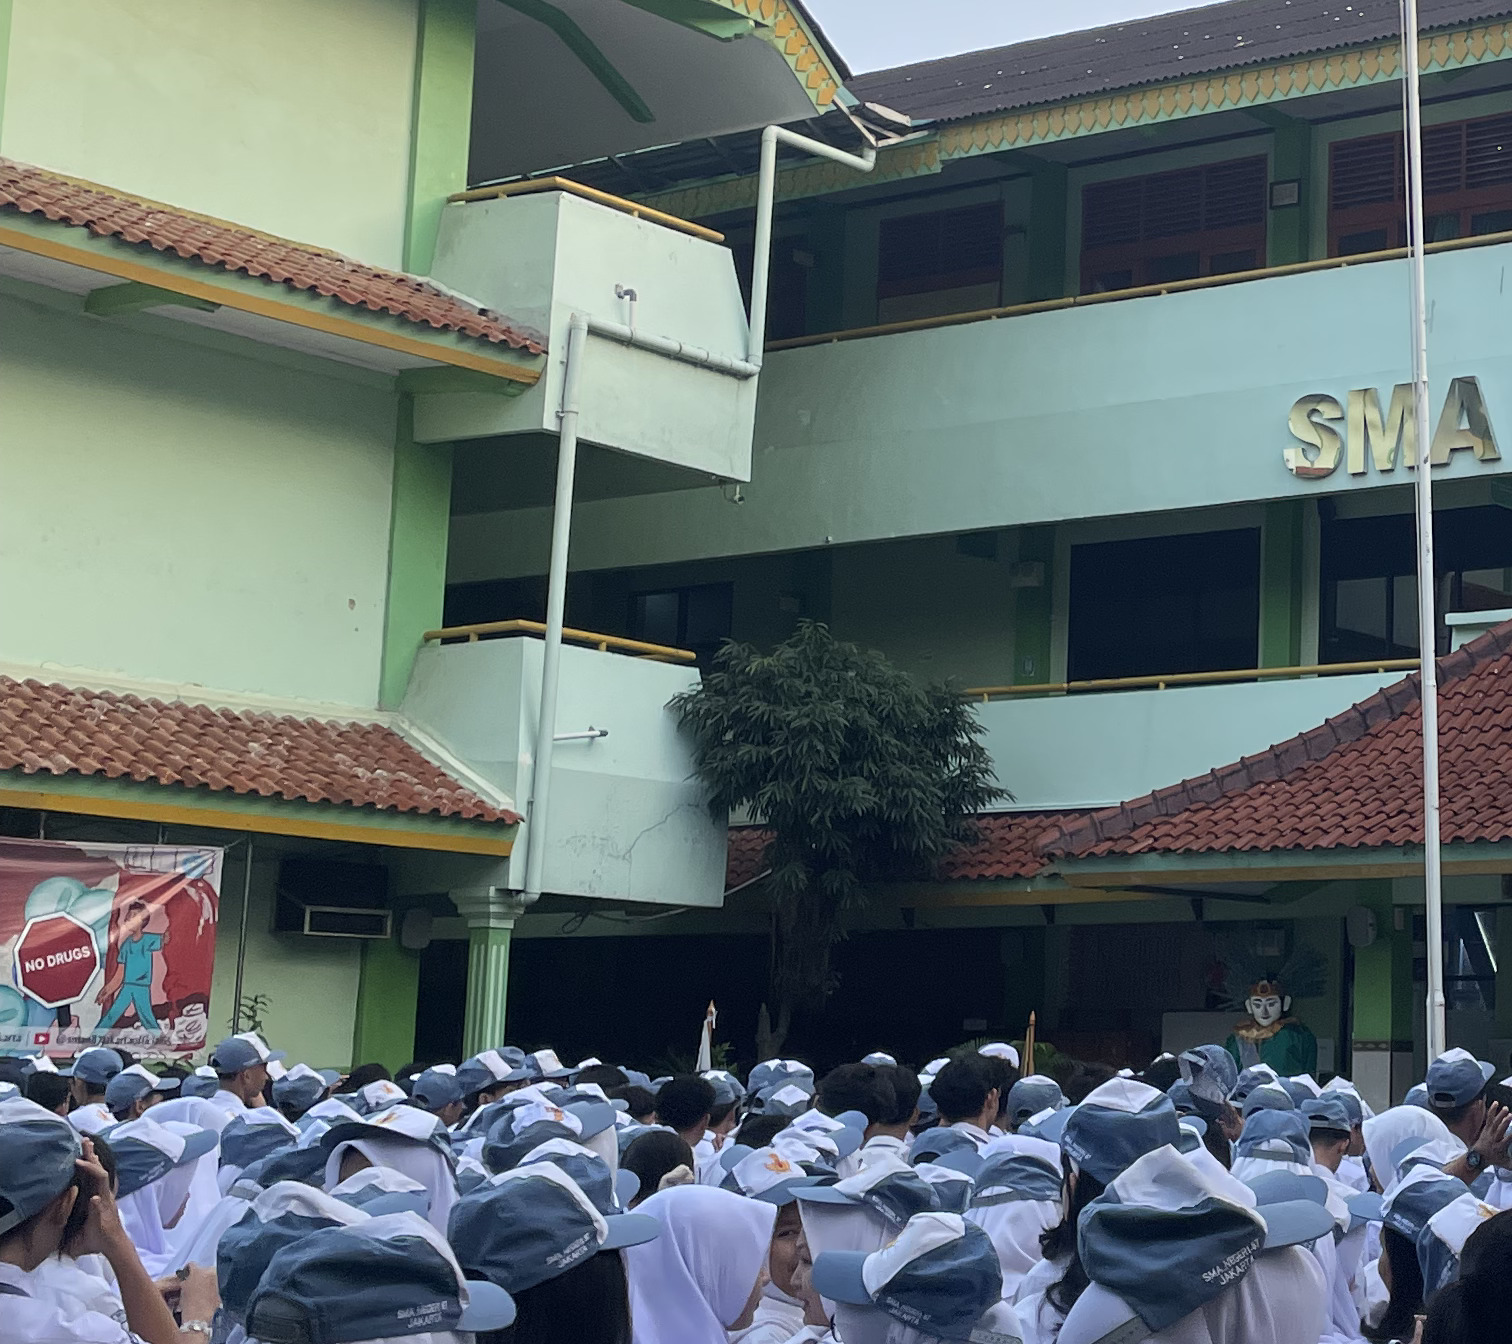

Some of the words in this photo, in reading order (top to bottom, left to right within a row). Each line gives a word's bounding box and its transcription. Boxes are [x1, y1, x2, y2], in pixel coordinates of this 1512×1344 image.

[24, 957, 45, 973] NO
[46, 945, 91, 967] DRUGS
[1202, 1265, 1224, 1283] SMA
[1222, 1245, 1252, 1268] NEGERI
[1220, 1255, 1255, 1285] JAKARTA
